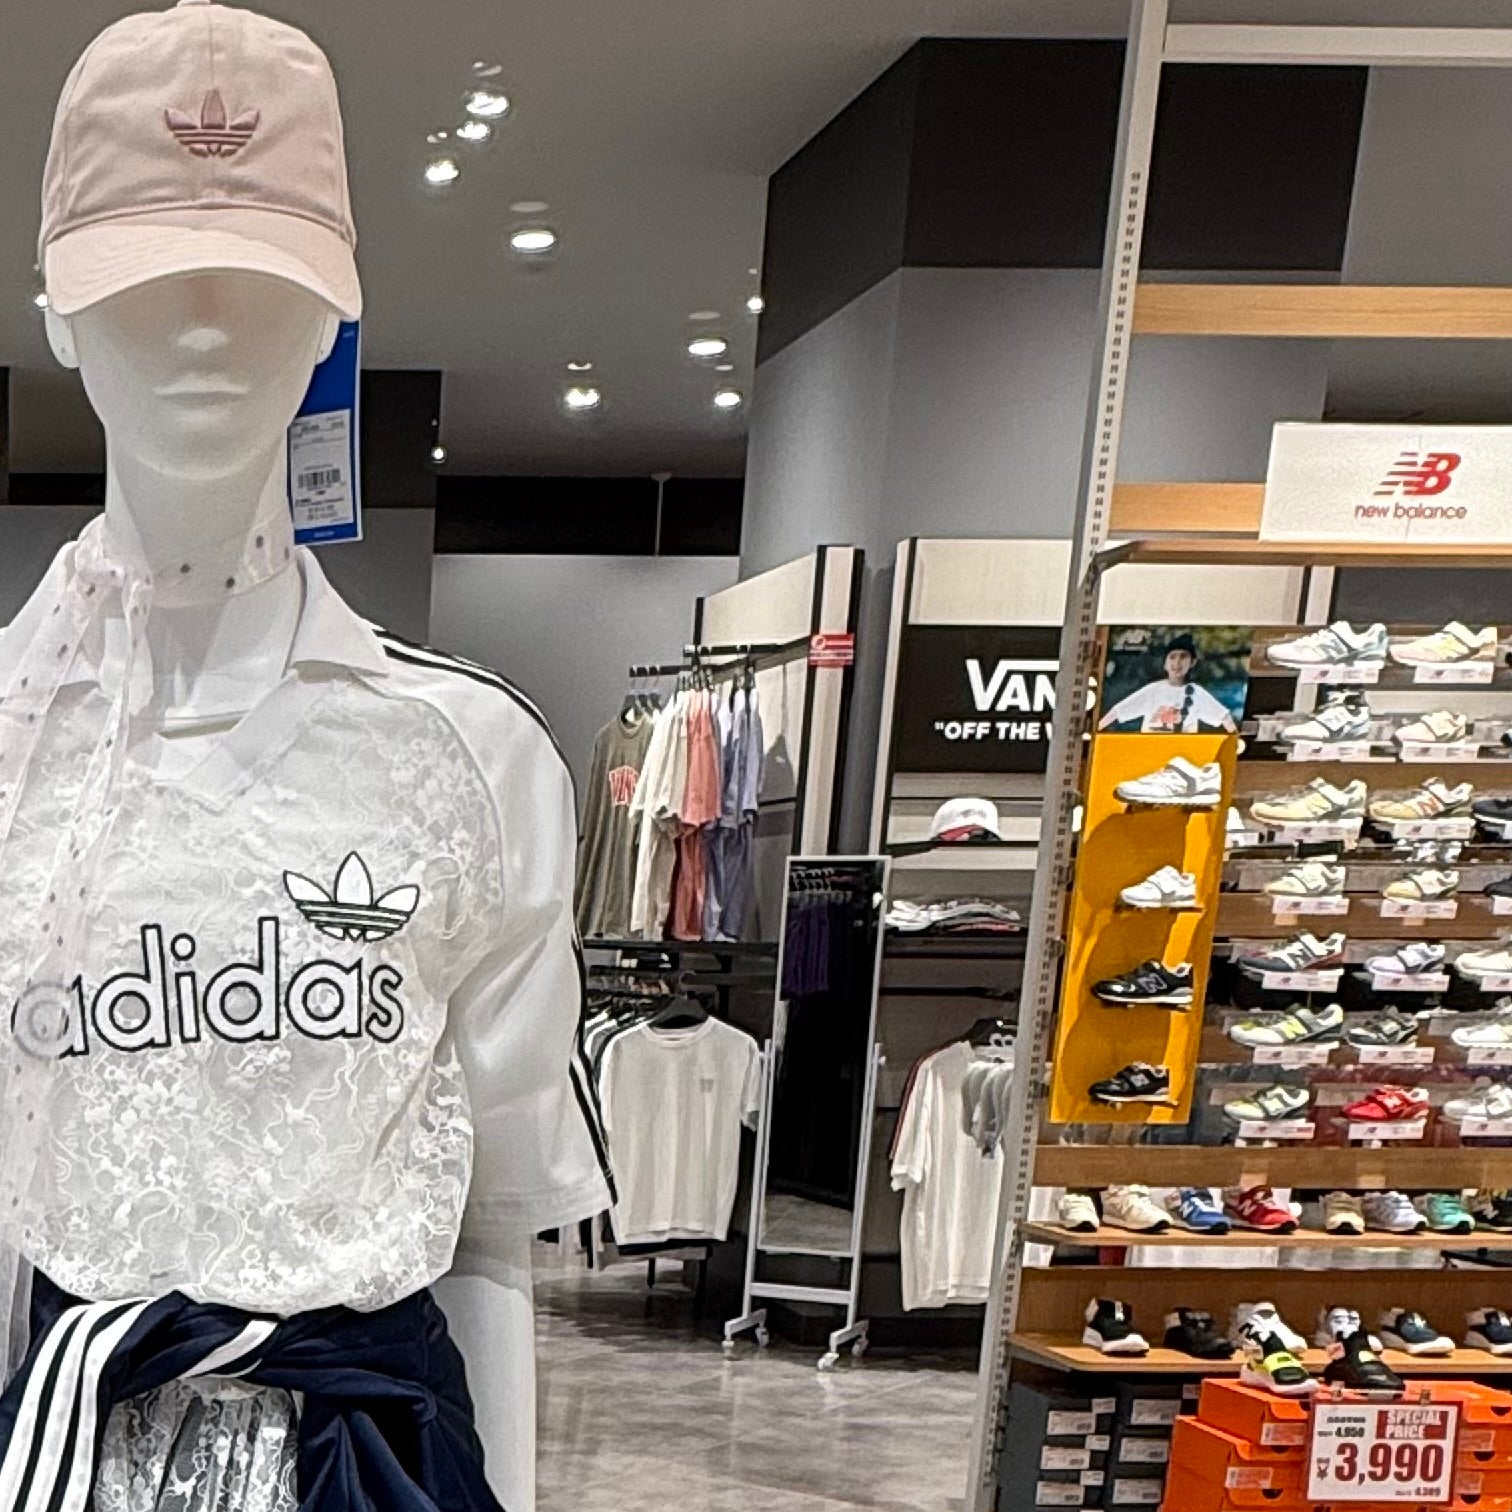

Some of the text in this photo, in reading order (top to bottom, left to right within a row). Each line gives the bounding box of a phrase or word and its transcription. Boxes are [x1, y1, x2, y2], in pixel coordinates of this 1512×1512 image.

[1354, 502, 1468, 519] new balance
[934, 721, 990, 740] "OFF
[995, 721, 1041, 741] THE
[10, 916, 404, 1060] adidas
[1387, 1410, 1442, 1425] SPECIAL
[1385, 1425, 1426, 1439] PRICE
[1335, 1443, 1444, 1485] 3,990
